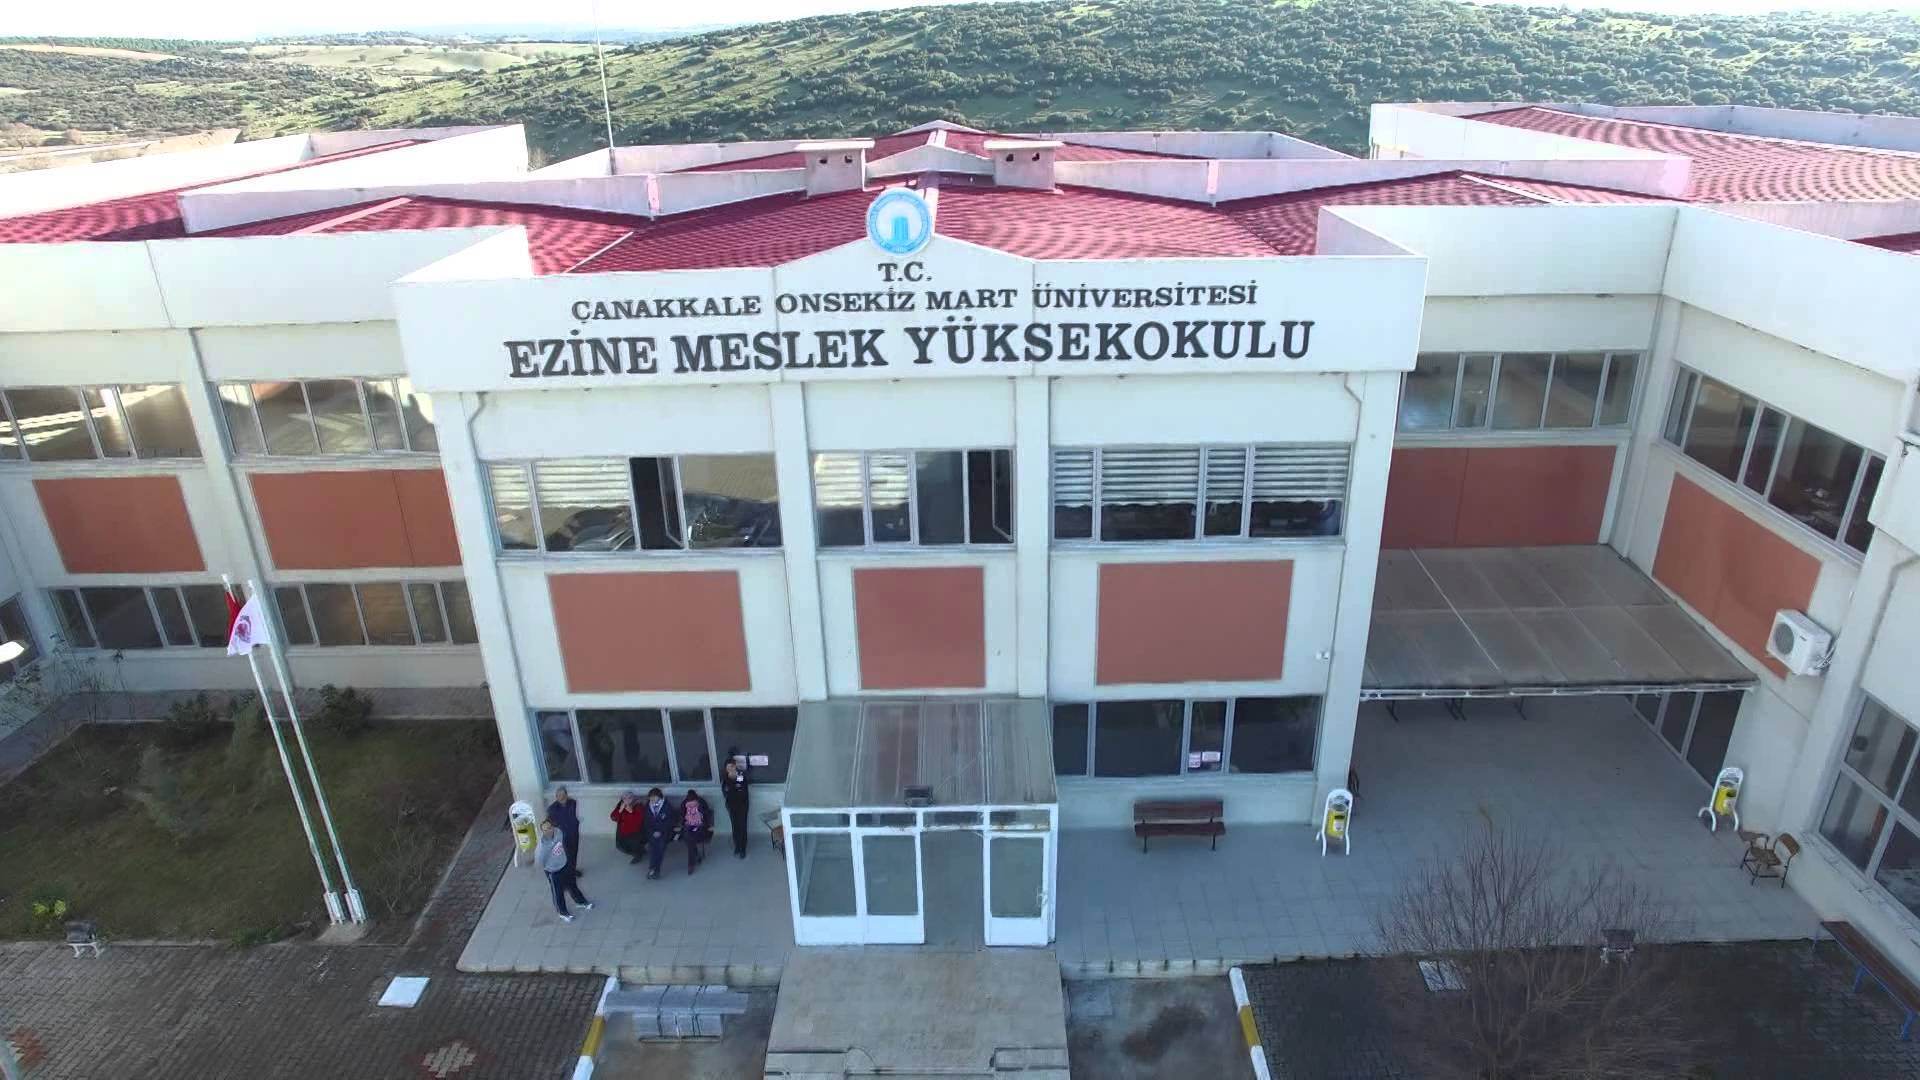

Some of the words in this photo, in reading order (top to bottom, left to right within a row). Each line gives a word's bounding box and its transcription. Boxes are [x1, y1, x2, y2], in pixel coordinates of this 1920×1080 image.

[878, 261, 933, 283] T.C.
[571, 295, 762, 324] ÇANAKKALE
[775, 287, 915, 314] ONSEKİZ
[925, 288, 1018, 311] MART
[1032, 279, 1258, 309] ÜNİVERSİTESİ
[503, 329, 658, 378] EZİNE
[670, 328, 888, 374] MESLEK
[904, 316, 1315, 364] YÜKSEKOKULU
